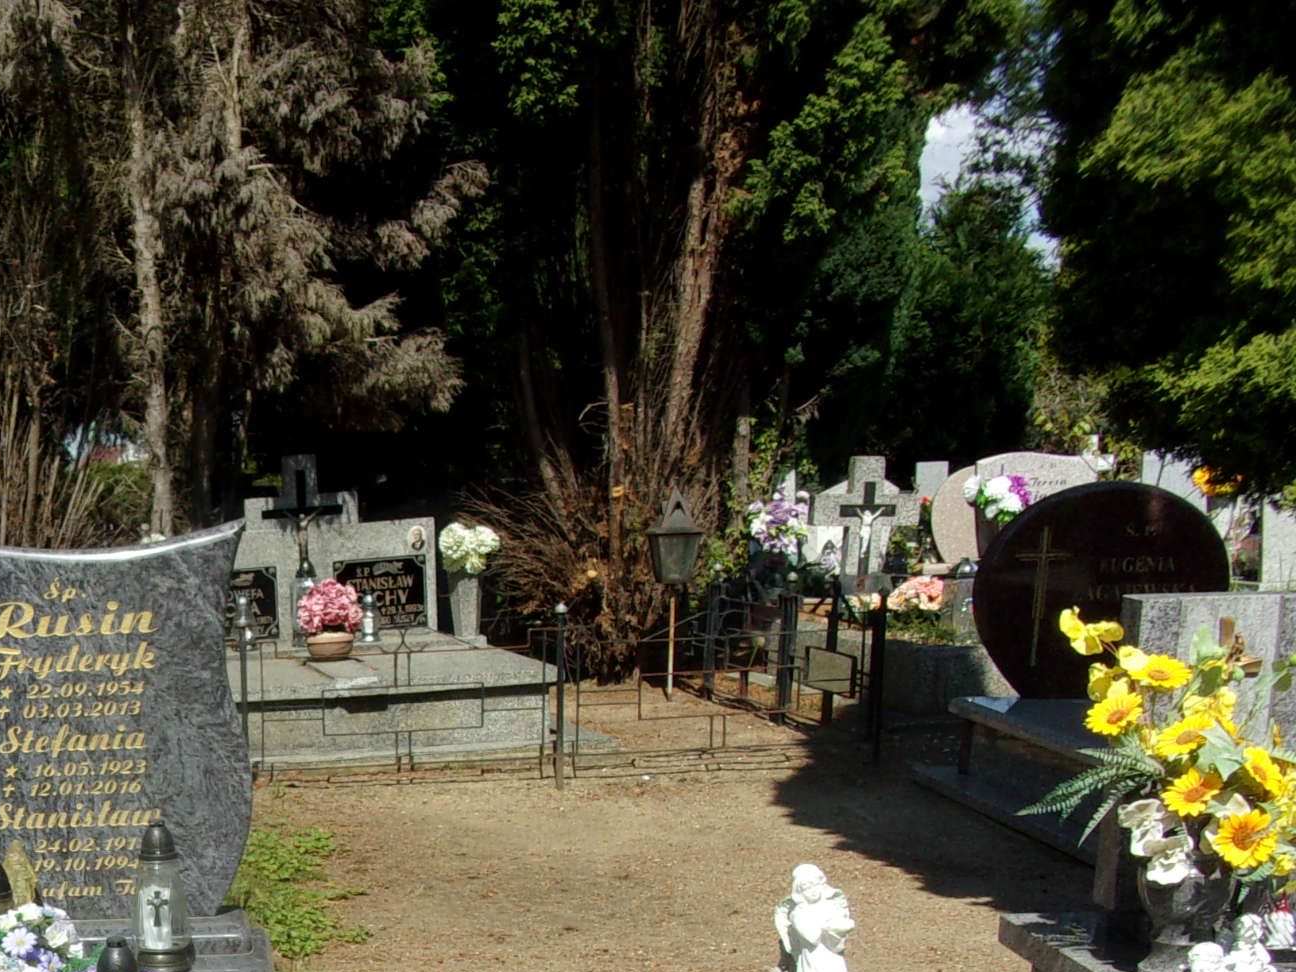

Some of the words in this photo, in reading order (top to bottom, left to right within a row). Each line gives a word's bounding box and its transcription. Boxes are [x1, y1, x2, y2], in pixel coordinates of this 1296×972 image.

[1099, 556, 1175, 573] EUGENIA
[346, 573, 414, 592] STANISŁAW
[25, 680, 145, 699] 22.09.1954
[23, 700, 142, 719] 03.03.2013
[34, 759, 148, 778] 16.05.1923
[30, 779, 142, 797] 12.01.2016
[34, 836, 138, 853] 24.02.191
[34, 855, 140, 873] 19.10.1994
